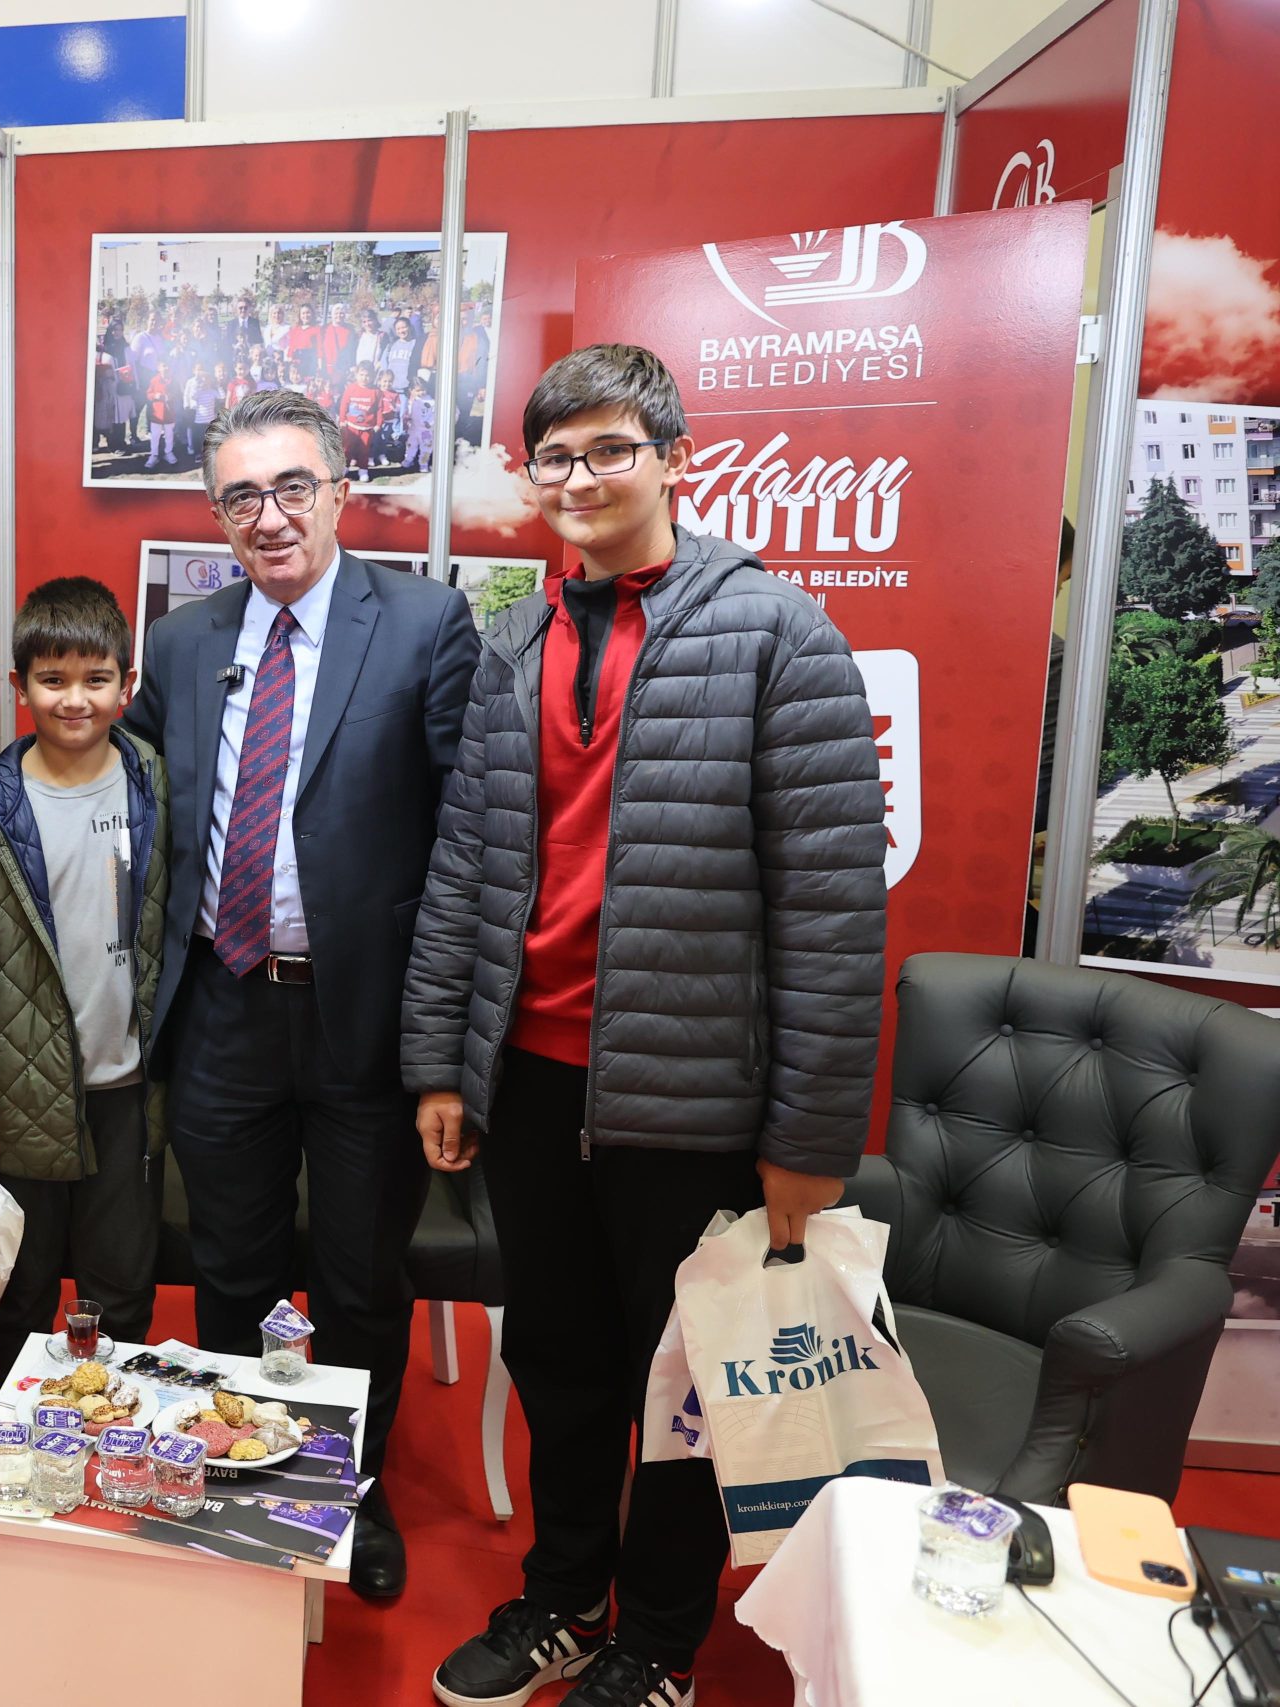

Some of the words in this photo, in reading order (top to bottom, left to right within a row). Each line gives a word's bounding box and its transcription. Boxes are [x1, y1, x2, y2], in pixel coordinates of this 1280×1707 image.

[700, 324, 923, 362] BAYRAMPAŞA
[698, 348, 923, 391] BELEDİYESİ
[684, 432, 912, 507] Hasan
[677, 490, 901, 553] MUTLU
[810, 566, 909, 588] BELEDİYE
[720, 1335, 881, 1398] Kronik
[108, 1431, 142, 1441] Sultan
